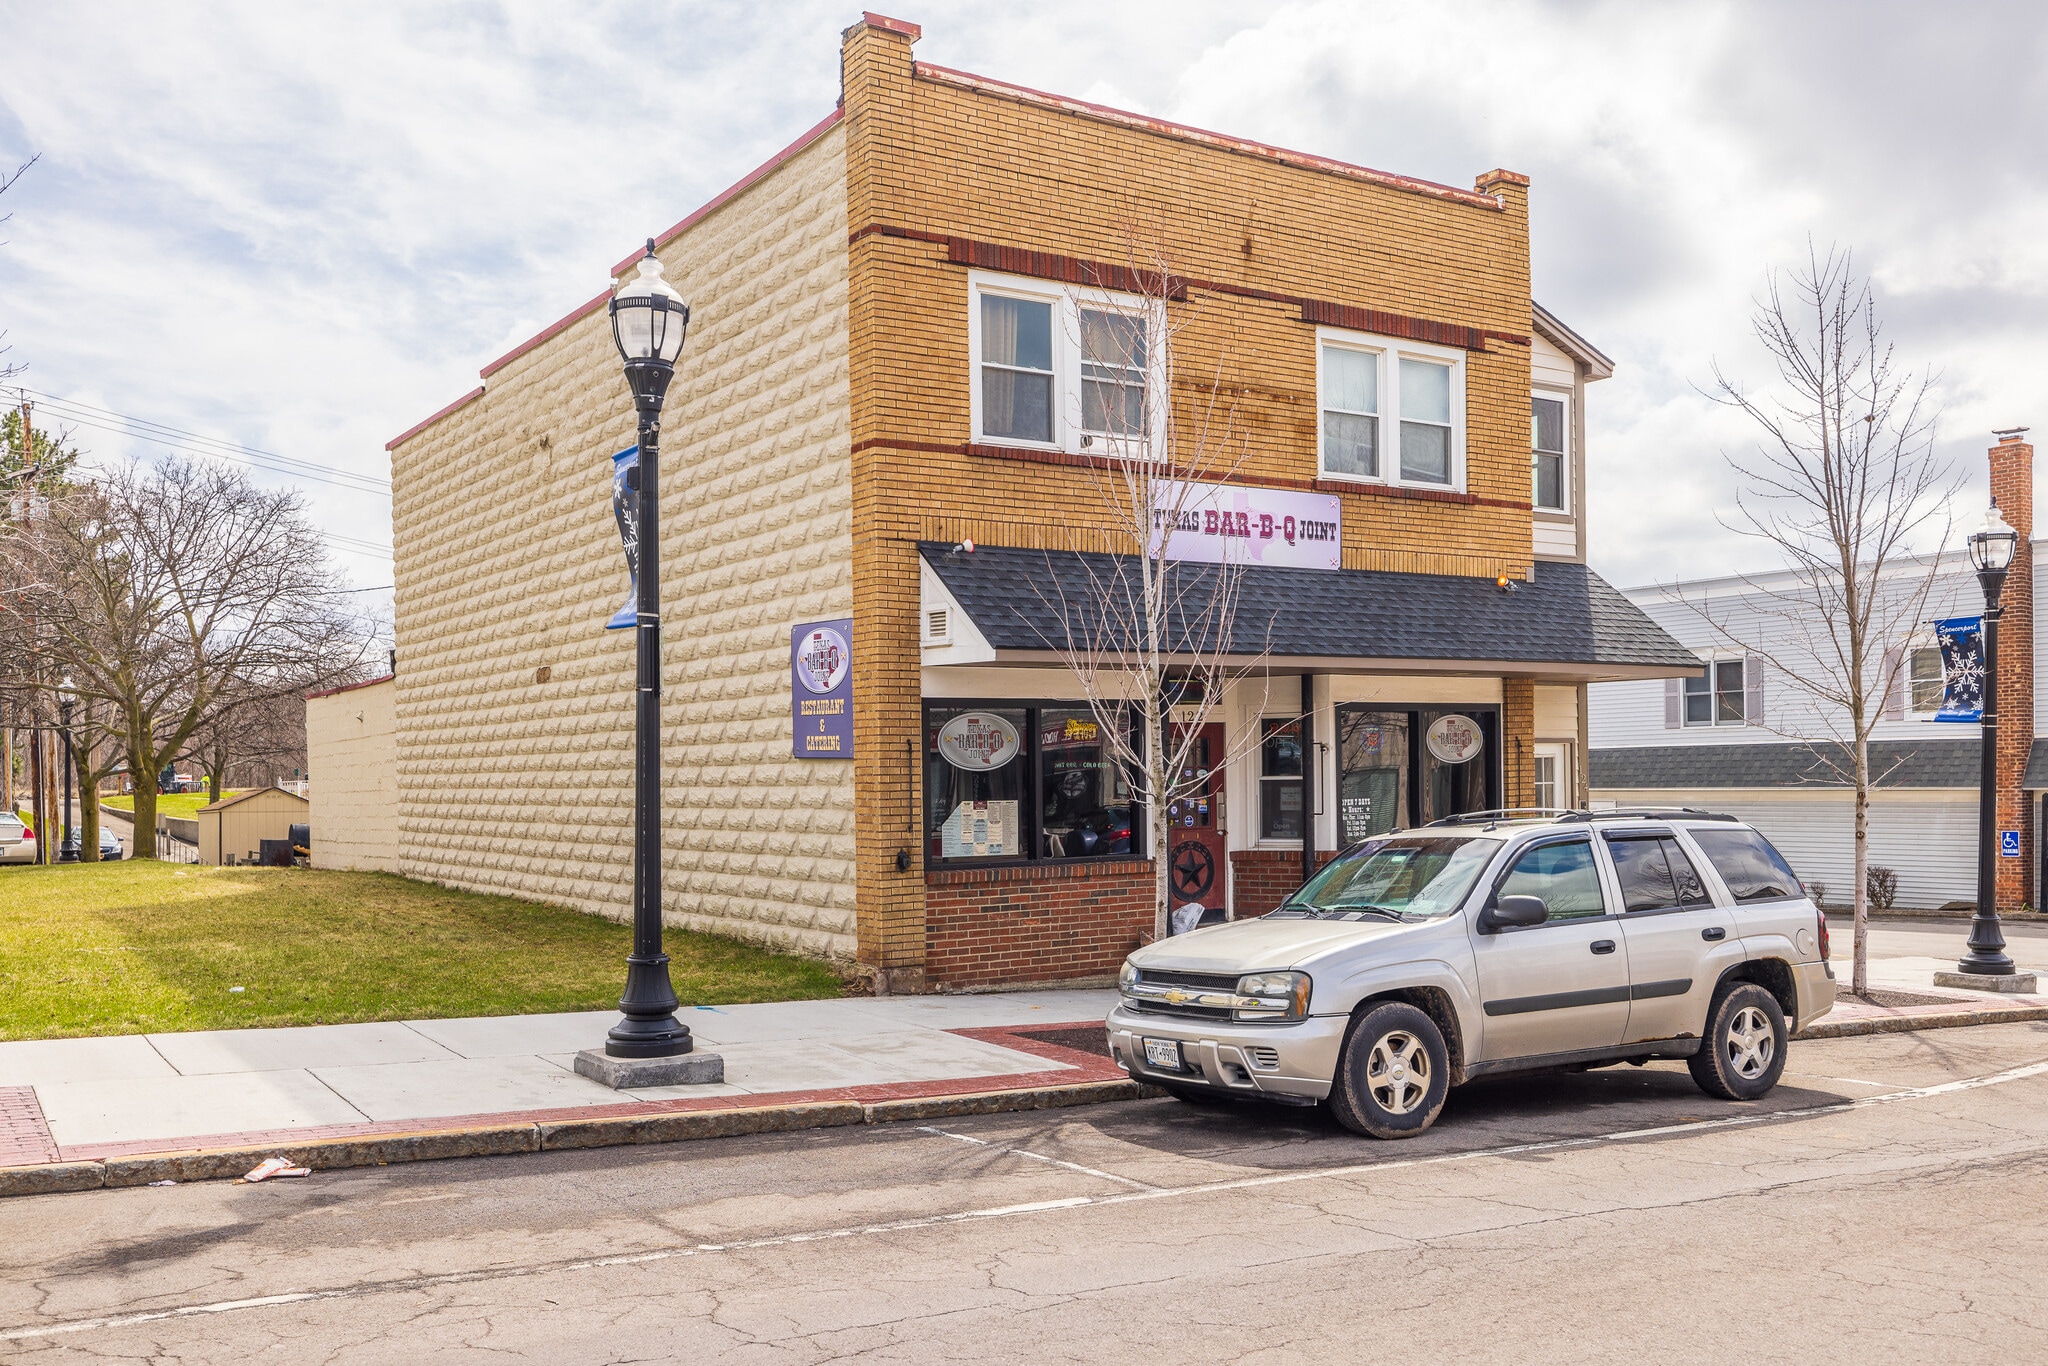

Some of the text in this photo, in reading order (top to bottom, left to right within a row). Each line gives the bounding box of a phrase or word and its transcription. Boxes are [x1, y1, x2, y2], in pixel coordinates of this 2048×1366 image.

[1204, 509, 1296, 546] BAR-B-Q
[1299, 520, 1337, 542] JOINT
[1939, 623, 1978, 634] Spencerport
[801, 699, 845, 715] RESTAURANT
[819, 719, 825, 732] &
[967, 724, 991, 733] TEXAS
[806, 735, 841, 751] CATERING
[1266, 737, 1300, 748] OPEN
[968, 750, 990, 758] JOINT
